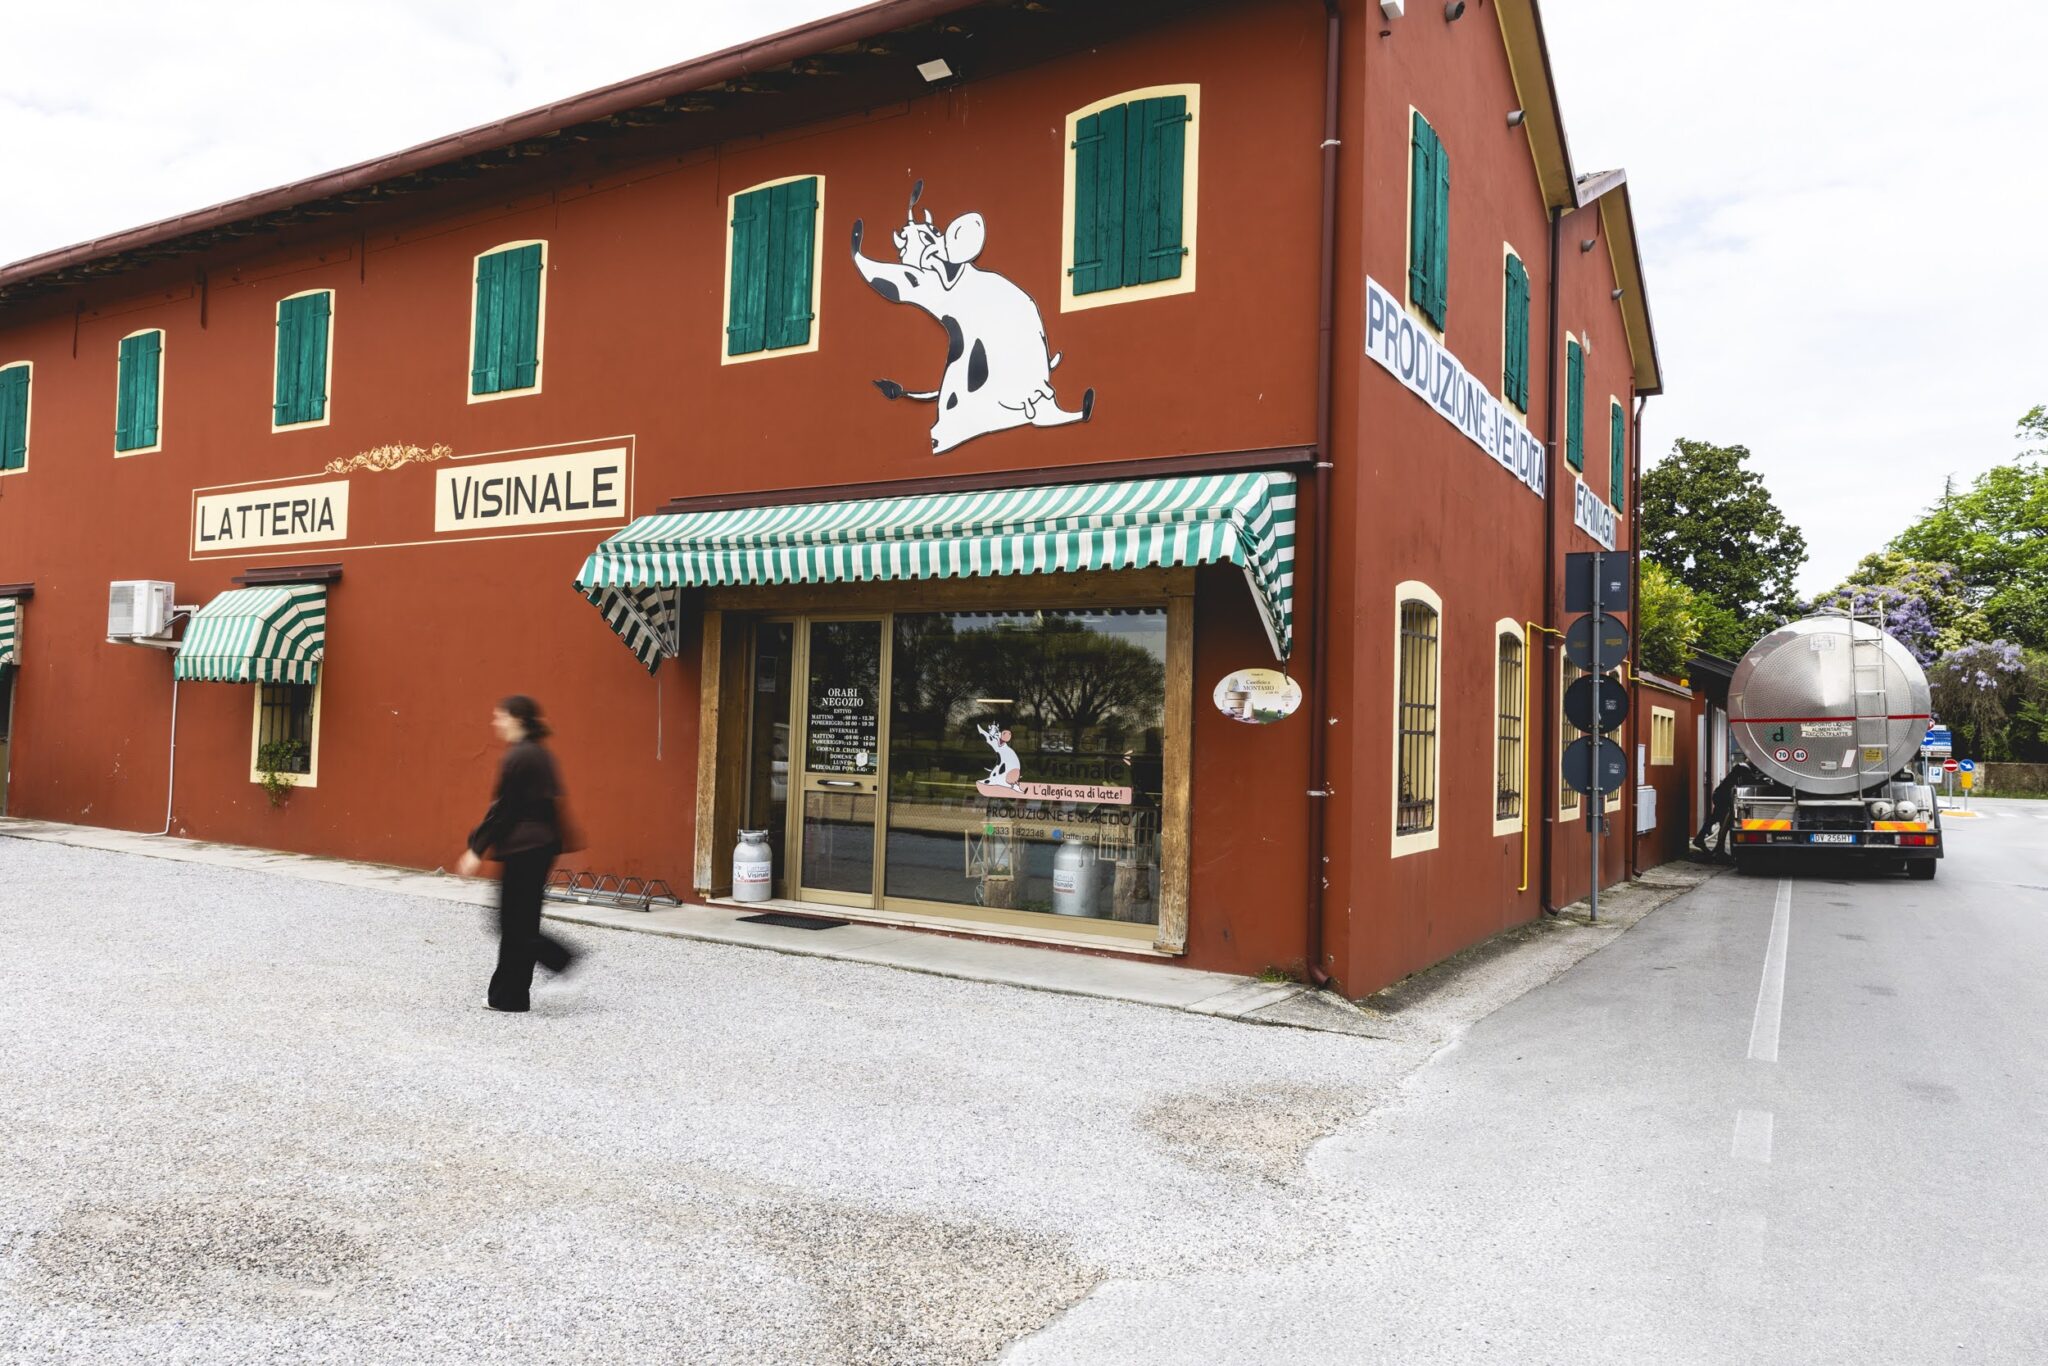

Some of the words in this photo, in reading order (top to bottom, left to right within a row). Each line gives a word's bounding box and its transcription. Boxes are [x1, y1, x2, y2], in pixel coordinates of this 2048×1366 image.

[1368, 286, 1487, 445] PRODUZIONE
[1493, 405, 1545, 493] VENDITA
[451, 466, 618, 520] VISINALE
[200, 497, 335, 541] LATTERIA
[828, 687, 858, 697] ORARI
[821, 697, 864, 707] NEGOZIO
[1033, 785, 1073, 799] L'allegria
[1074, 789, 1085, 797] sa
[1087, 787, 1095, 797] di
[1097, 787, 1123, 800] latte!
[986, 806, 1064, 822] PRODUZIONE
